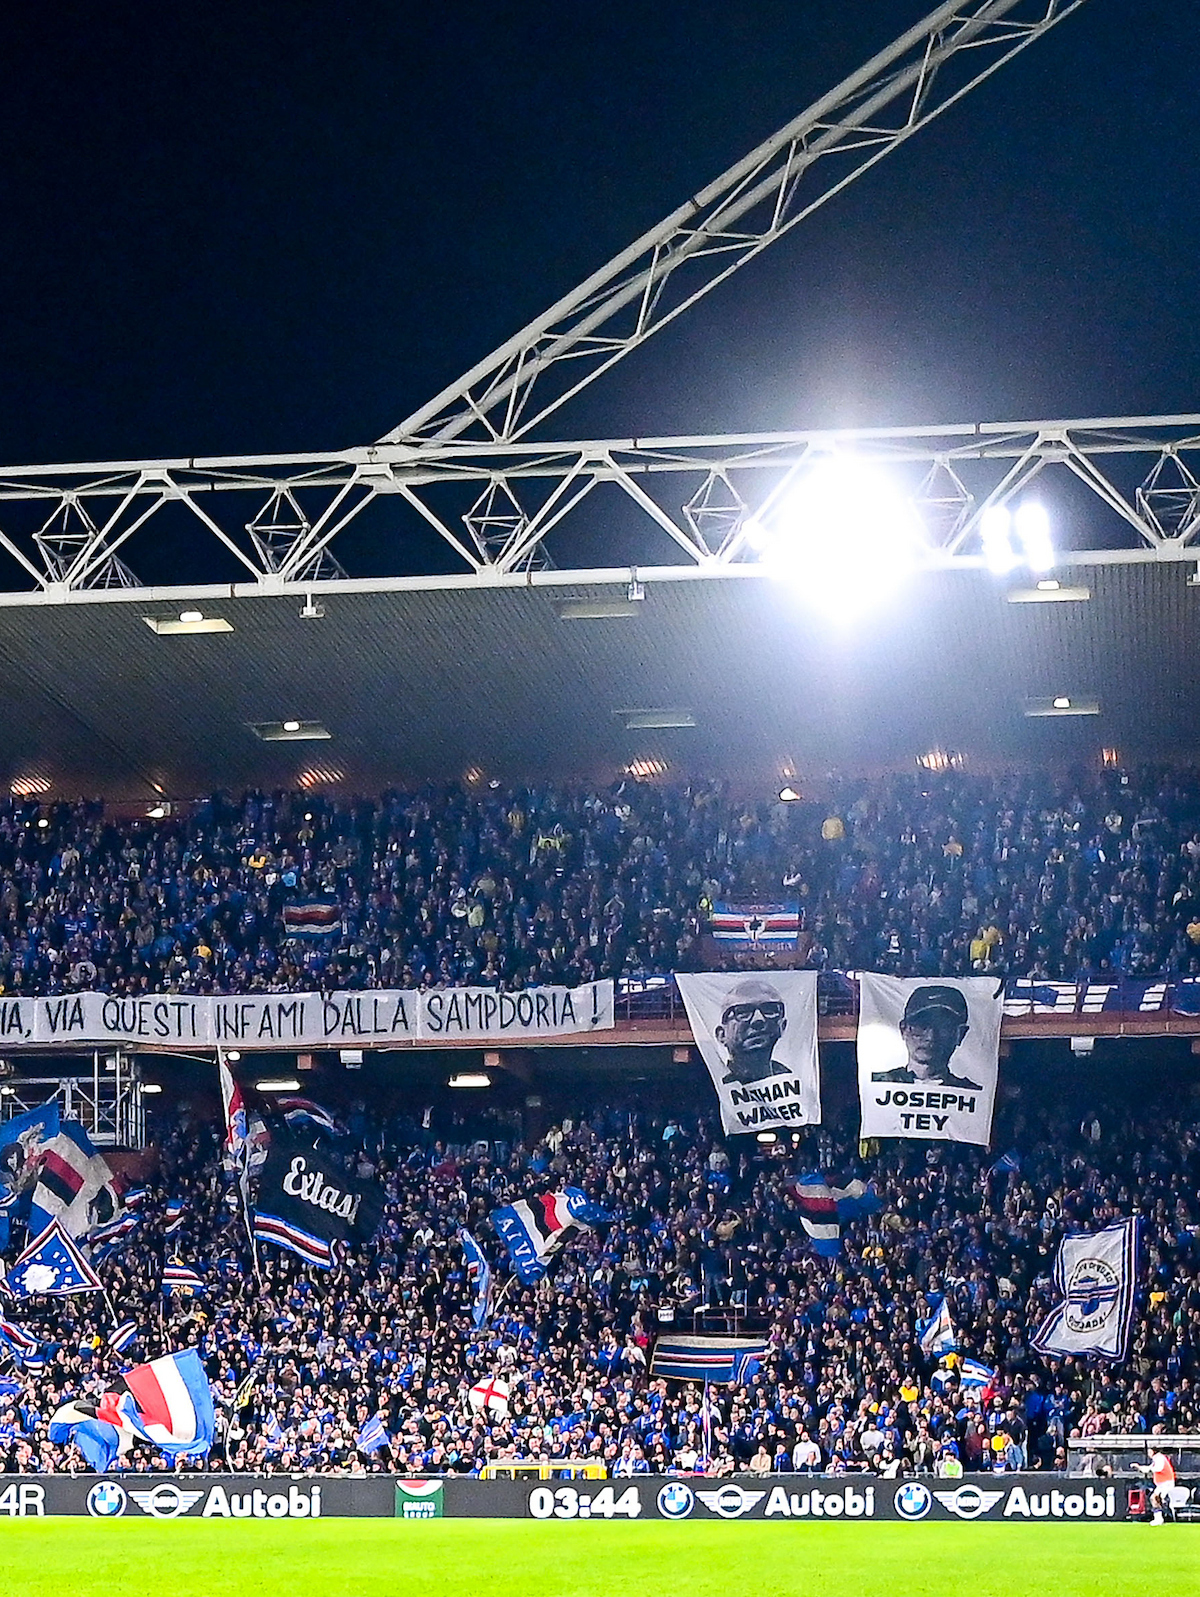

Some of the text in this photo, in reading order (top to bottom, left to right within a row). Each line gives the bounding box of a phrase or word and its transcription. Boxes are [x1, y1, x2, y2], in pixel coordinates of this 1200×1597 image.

[46, 997, 85, 1033] VIA
[102, 999, 196, 1037] QUESTI
[216, 1001, 305, 1039] INFAMI
[323, 997, 409, 1036] DALLA
[427, 991, 576, 1032] SAMPDORIA
[875, 1090, 976, 1113] JOSEPH
[900, 1113, 949, 1131] TEY
[202, 1485, 321, 1517] Autobi
[529, 1486, 642, 1518] 03:44
[764, 1486, 875, 1516] Autobi
[1003, 1486, 1115, 1517] Autobi
